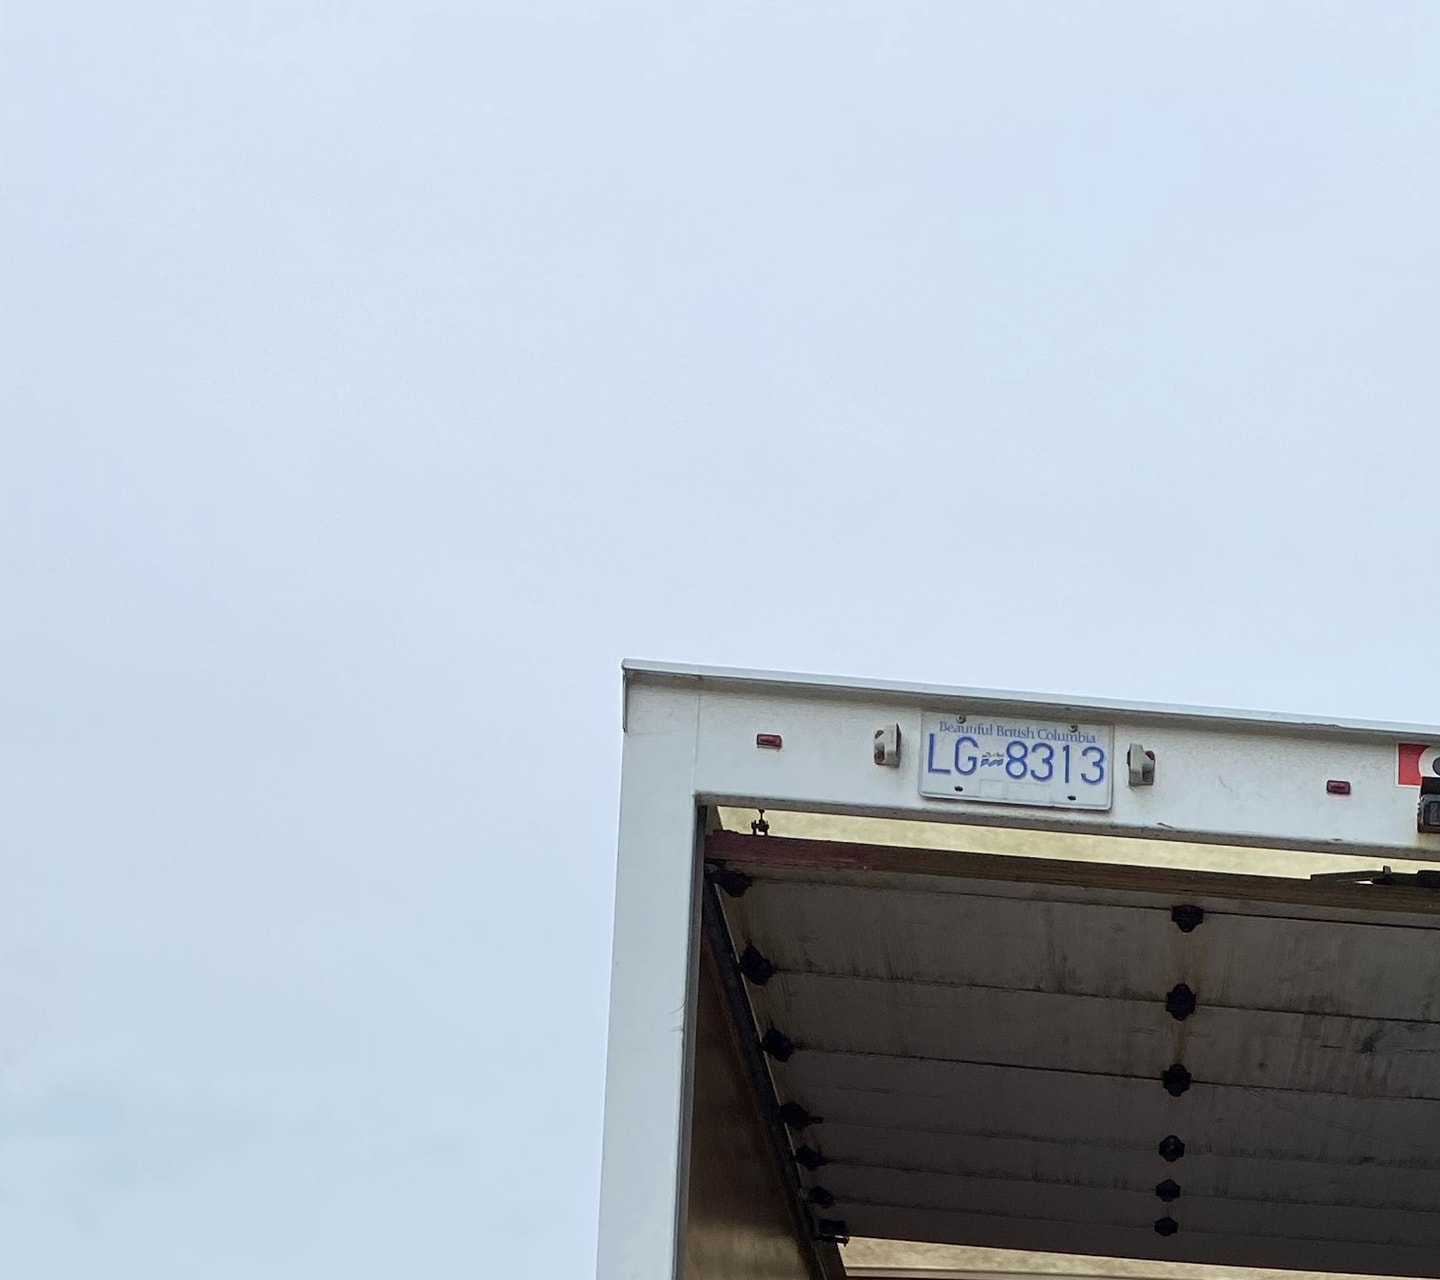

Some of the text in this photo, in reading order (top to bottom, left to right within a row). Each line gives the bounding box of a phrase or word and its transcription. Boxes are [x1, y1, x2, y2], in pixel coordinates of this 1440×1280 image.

[939, 720, 1097, 744] Beautiful British Columbia
[928, 733, 1105, 786] LG 8313
